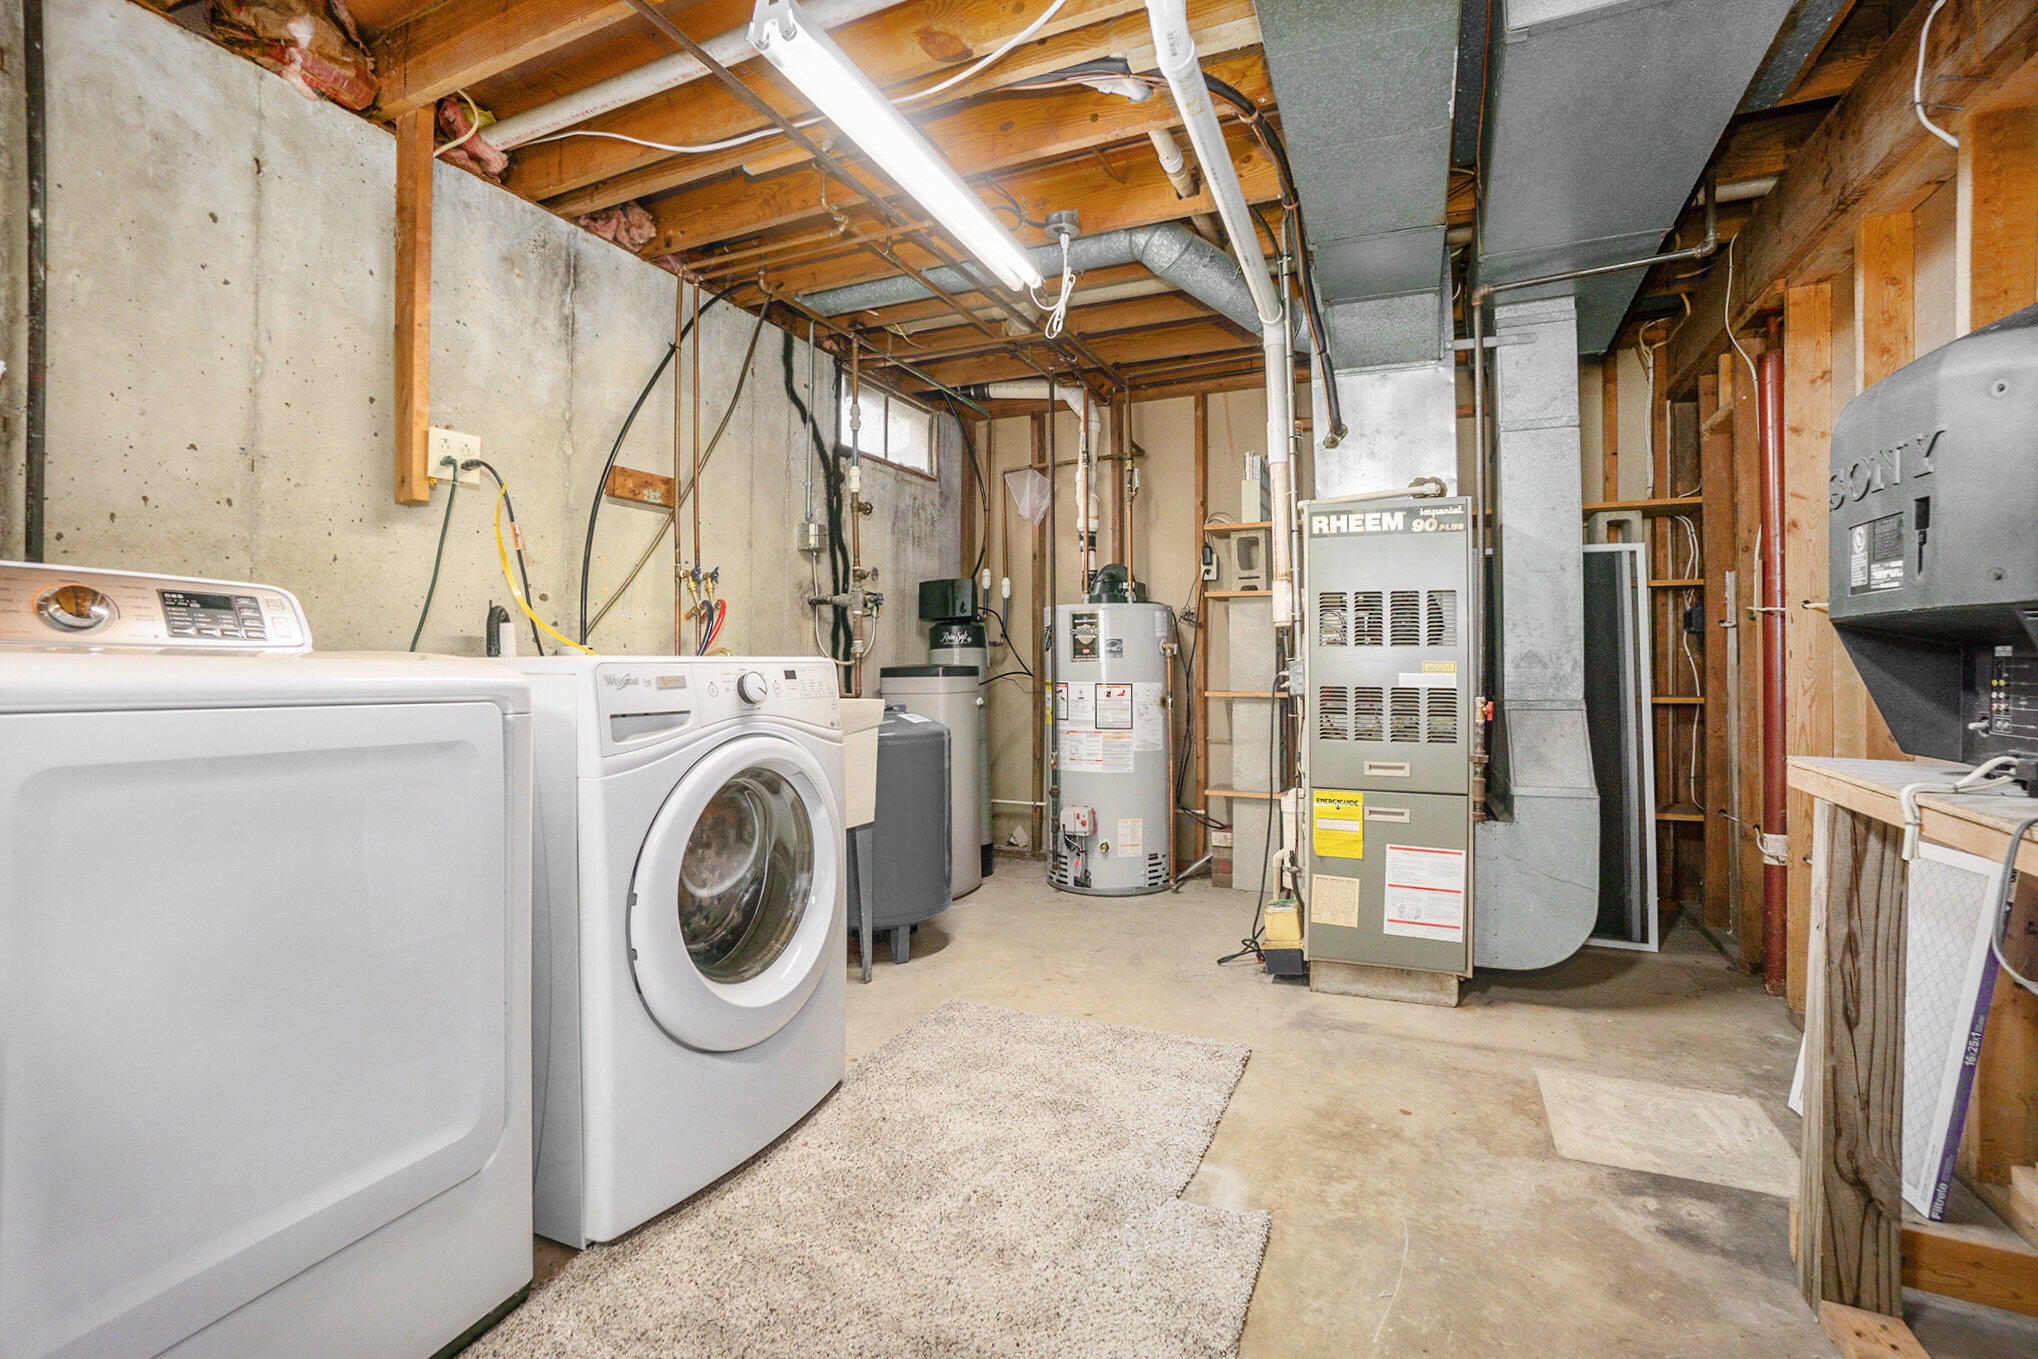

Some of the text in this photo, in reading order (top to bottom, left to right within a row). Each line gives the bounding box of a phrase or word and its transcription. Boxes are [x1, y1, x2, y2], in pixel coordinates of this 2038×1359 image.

[1829, 429, 1948, 511] SONY
[1312, 511, 1404, 534] RHEEM
[1411, 518, 1464, 533] 90 PLUS
